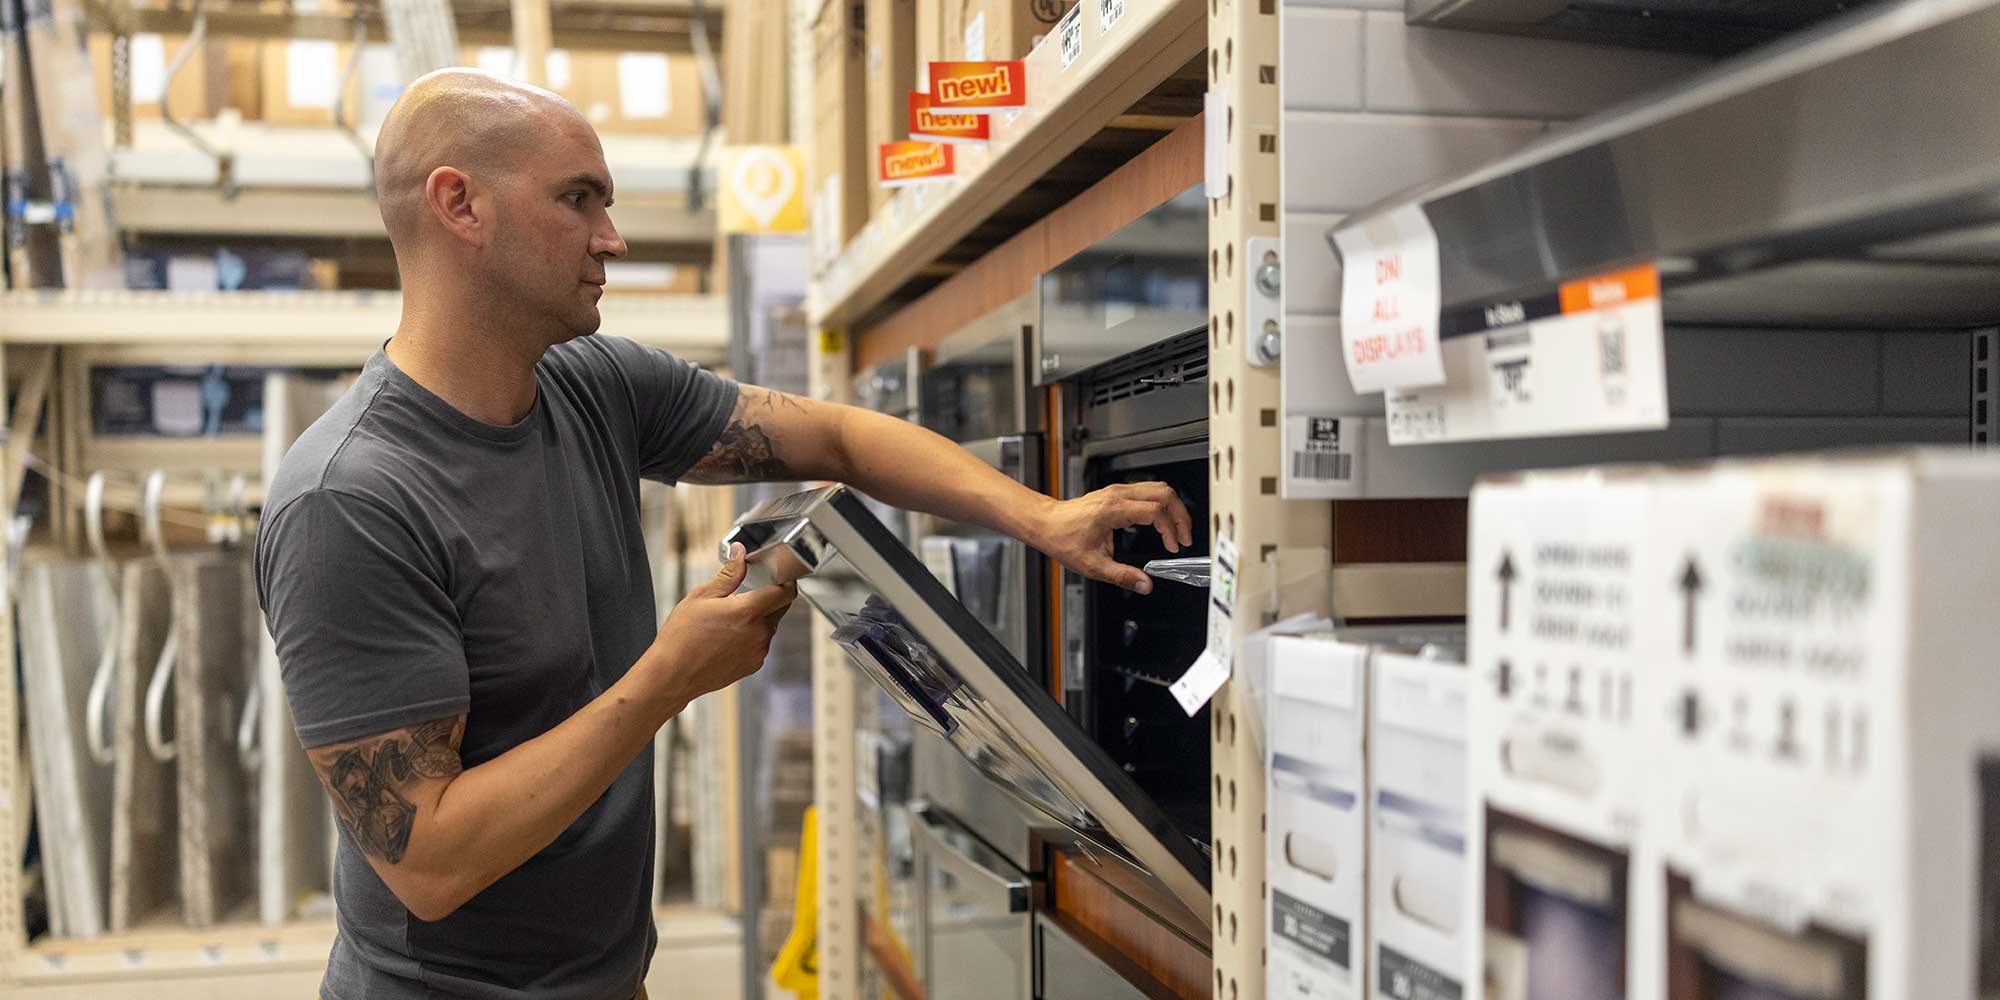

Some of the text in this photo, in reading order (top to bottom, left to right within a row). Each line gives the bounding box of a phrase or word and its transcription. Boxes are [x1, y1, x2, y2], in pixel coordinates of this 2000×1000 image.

[939, 68, 1010, 101] new!
[888, 146, 943, 174] new!
[1373, 298, 1402, 321] ALL
[1352, 327, 1425, 364] DISPLAYS
